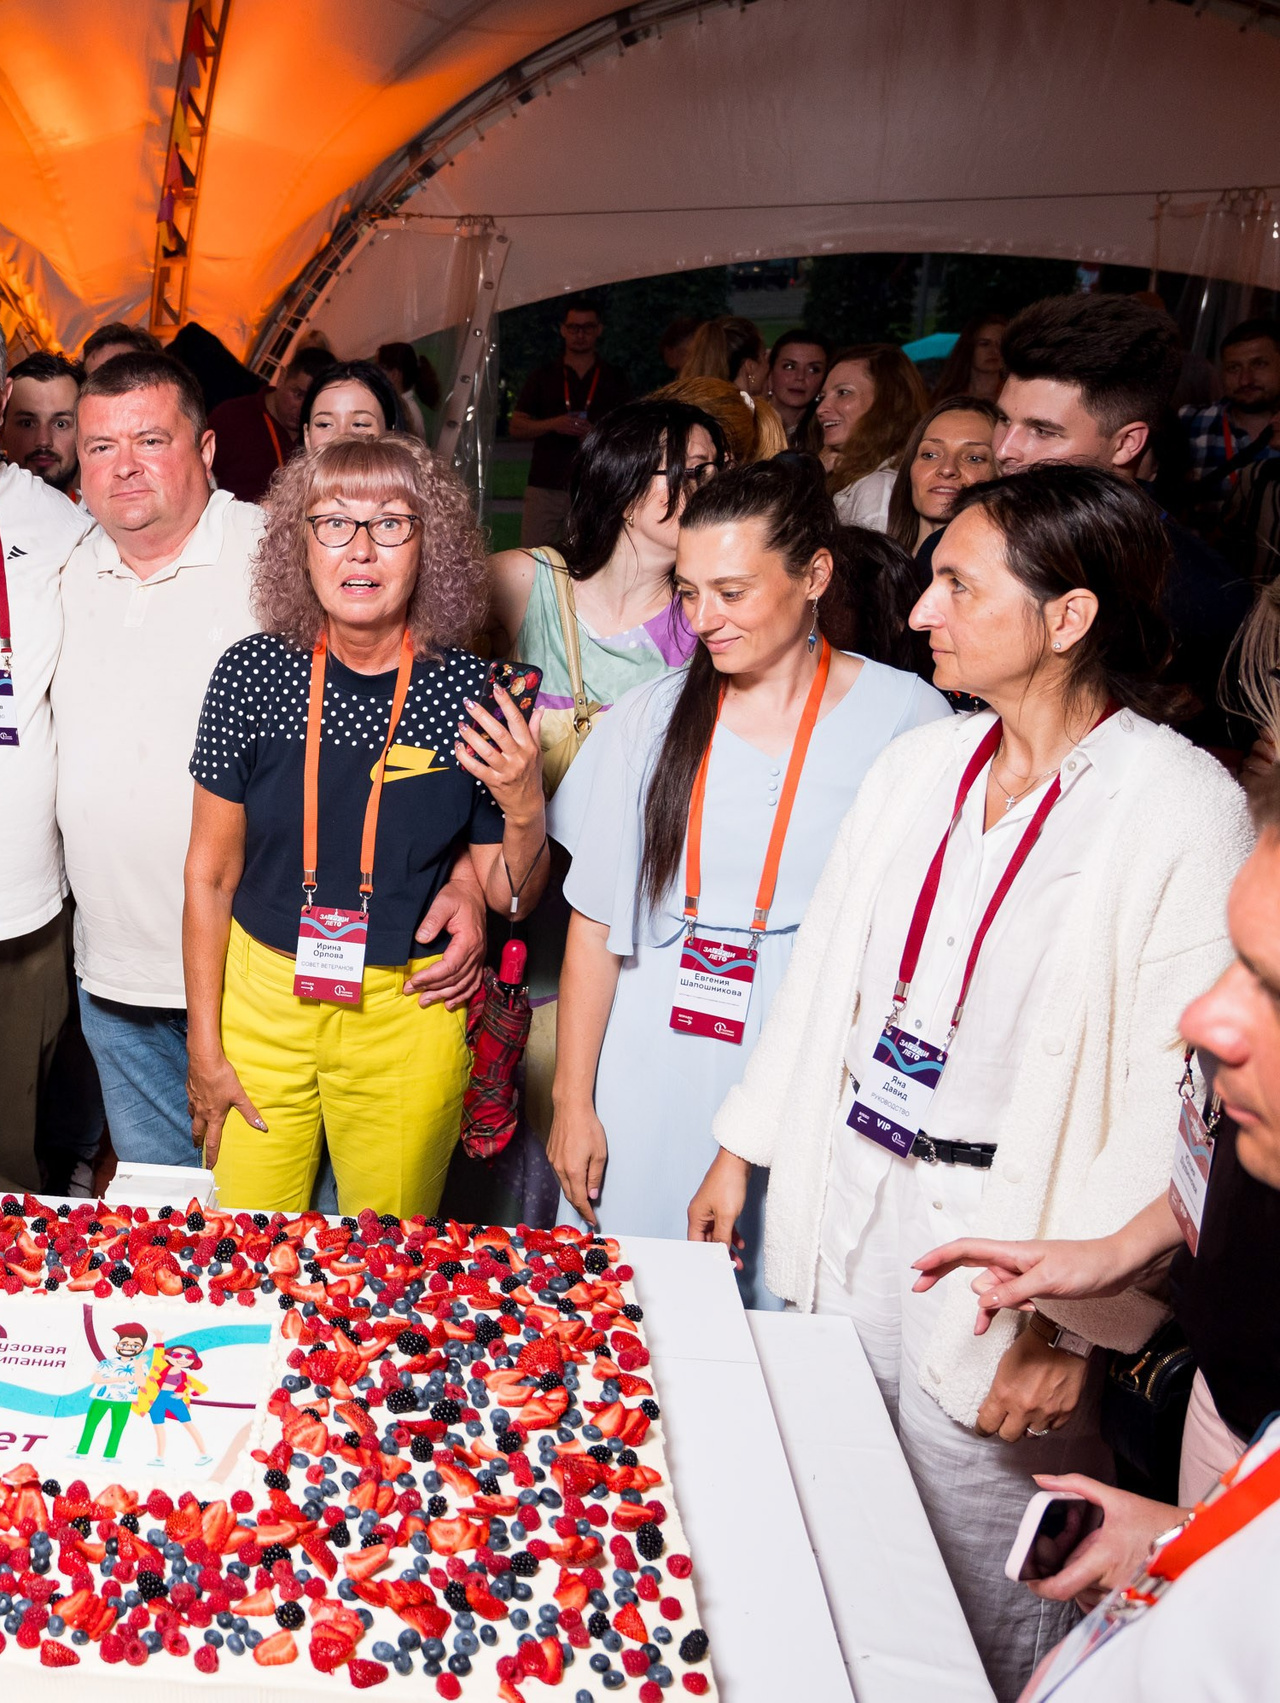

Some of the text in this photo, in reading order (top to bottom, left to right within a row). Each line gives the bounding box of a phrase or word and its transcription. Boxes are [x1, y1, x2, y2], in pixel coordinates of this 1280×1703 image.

[316, 942, 342, 951] Ирина
[313, 949, 344, 959] Орлова
[708, 953, 728, 962] ЛЕТО
[301, 960, 354, 971] СОВЕТ ВЕТЕРАНОВ
[694, 972, 730, 986] Евгения
[680, 978, 742, 997] Шапошникова
[901, 1048, 920, 1061] ЛЕТО
[890, 1075, 907, 1089] Яна
[882, 1081, 908, 1101] Давид
[870, 1091, 910, 1117] РУКОВОДСТВО
[876, 1118, 892, 1131] VIP
